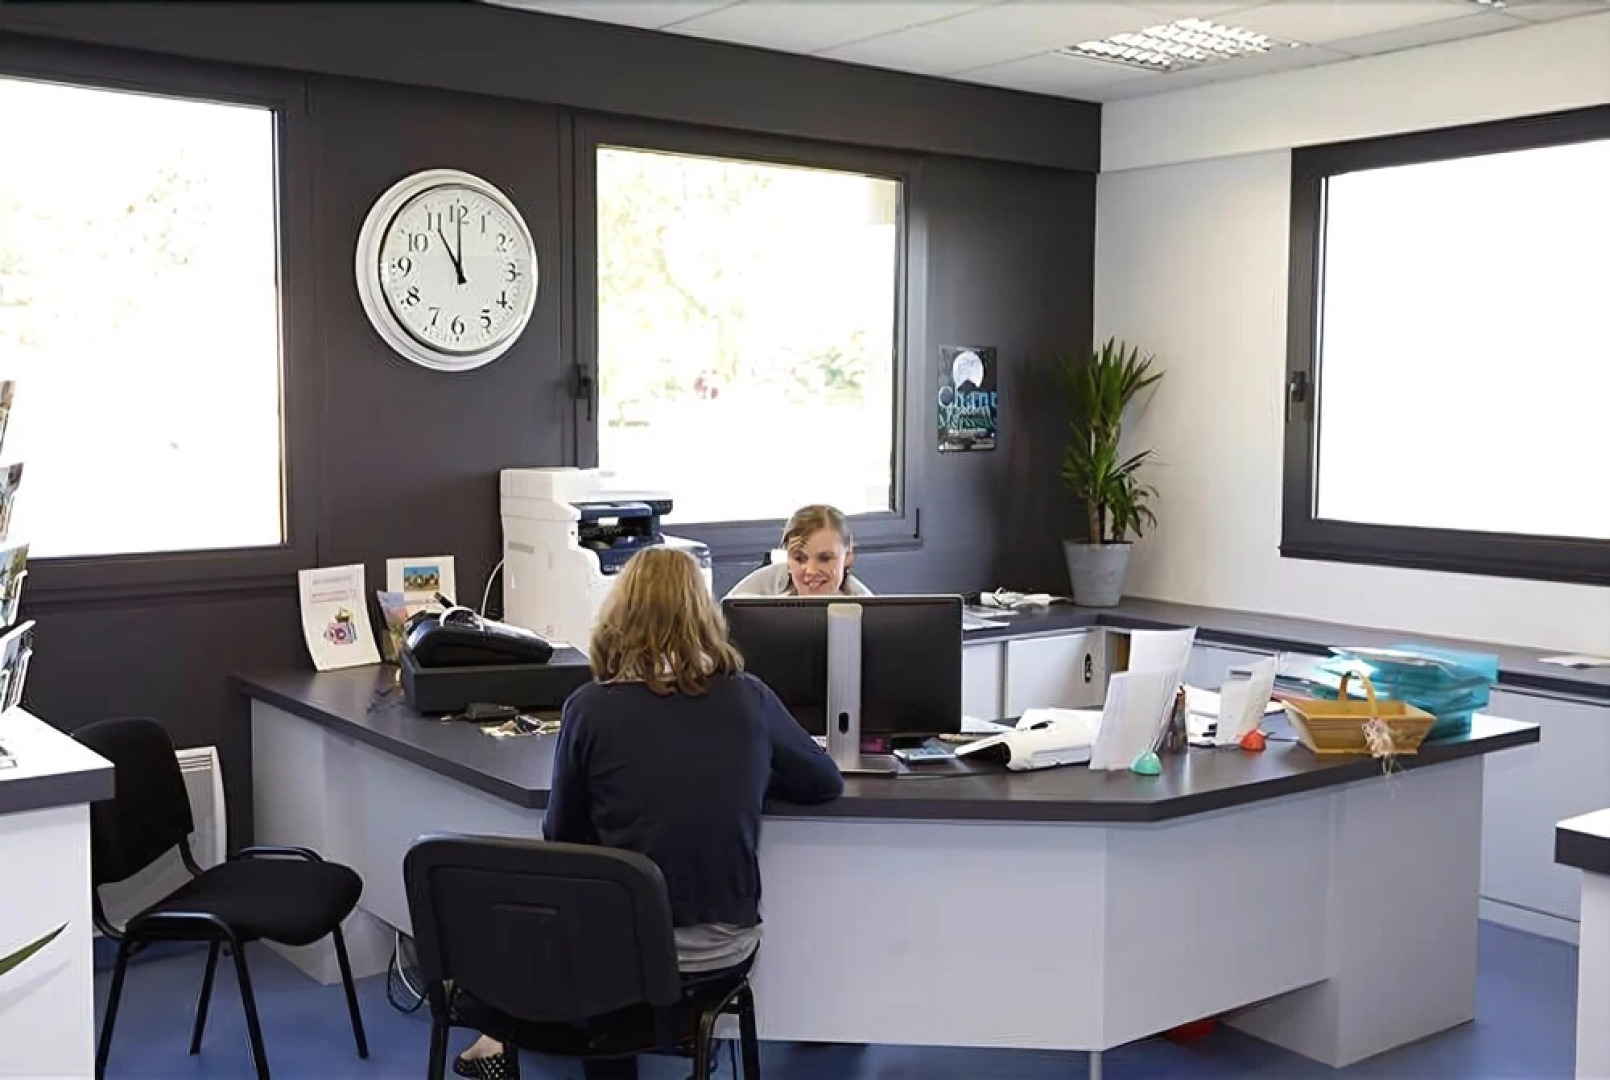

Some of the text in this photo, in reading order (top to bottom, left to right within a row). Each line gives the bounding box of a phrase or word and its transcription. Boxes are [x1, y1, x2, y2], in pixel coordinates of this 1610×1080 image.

[450, 205, 470, 224] 12
[481, 215, 486, 233] 1
[407, 232, 429, 252] 10
[496, 233, 508, 253] 2
[397, 256, 413, 277] 9
[505, 262, 517, 282] 3
[405, 286, 421, 307] 8
[496, 290, 508, 308] 4
[428, 306, 441, 326] 7
[451, 315, 465, 336] 6
[480, 309, 492, 330] 5
